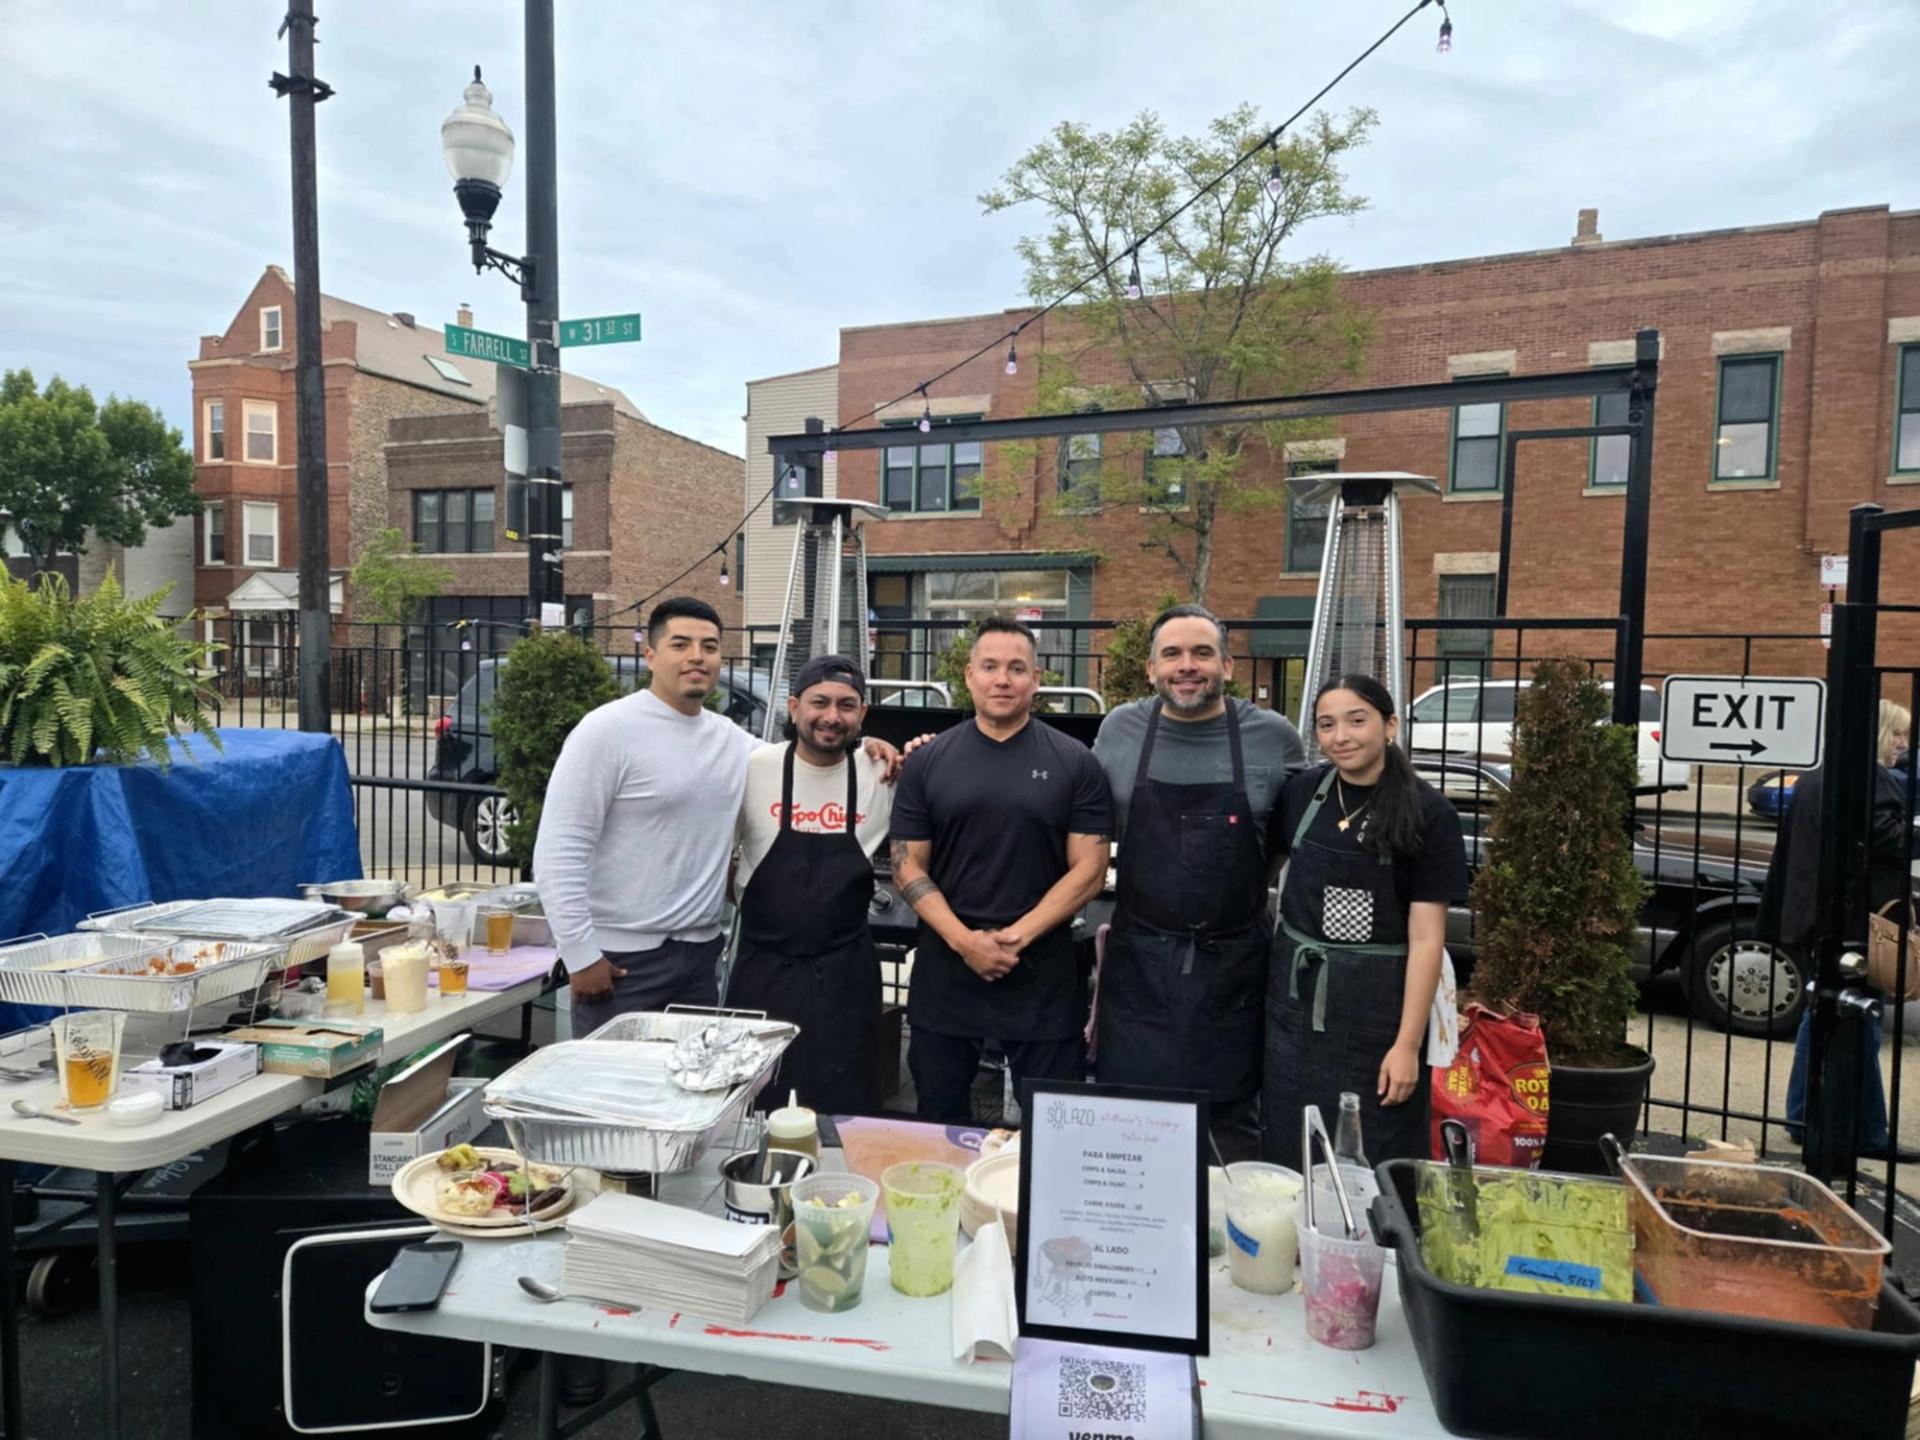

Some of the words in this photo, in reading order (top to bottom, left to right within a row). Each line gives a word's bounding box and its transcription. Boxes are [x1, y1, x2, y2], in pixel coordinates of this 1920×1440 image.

[569, 328, 576, 339] W
[451, 333, 457, 347] S
[463, 332, 515, 362] FARRELL
[1692, 693, 1796, 730] EXIT
[769, 802, 820, 827] Tpo
[1526, 1095, 1549, 1110] OA
[1047, 1102, 1096, 1130] SOLAZO
[1514, 1136, 1539, 1147] 100%
[373, 1154, 414, 1163] STANDARD
[1082, 1150, 1104, 1159] PARA
[1105, 1152, 1143, 1162] EMPEZAR
[1094, 1244, 1104, 1253] AL
[1106, 1246, 1130, 1255] LADO
